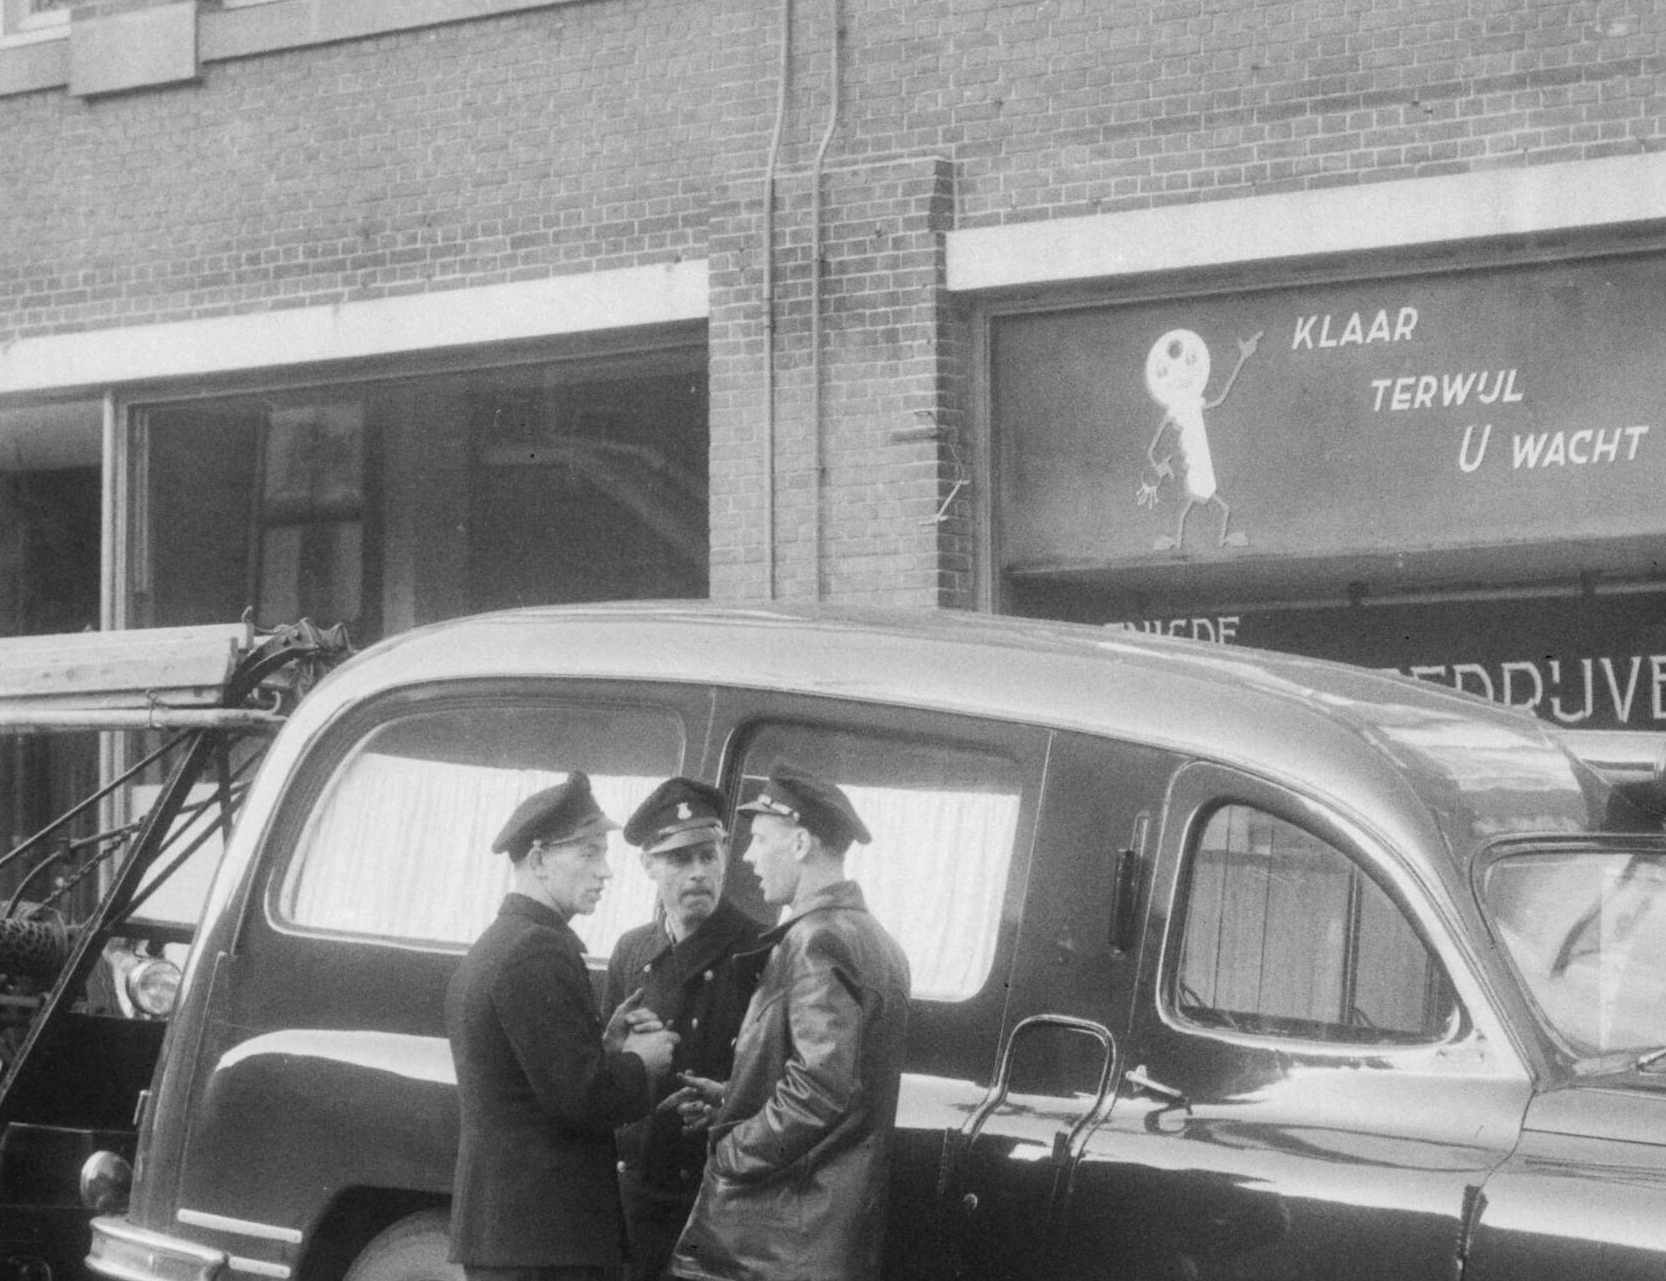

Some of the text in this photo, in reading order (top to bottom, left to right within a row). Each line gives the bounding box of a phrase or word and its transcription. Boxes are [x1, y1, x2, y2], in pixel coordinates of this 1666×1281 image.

[1291, 306, 1419, 351] KLAAR
[1370, 368, 1525, 413] TERWIJL
[1457, 423, 1650, 474] U WACHT
